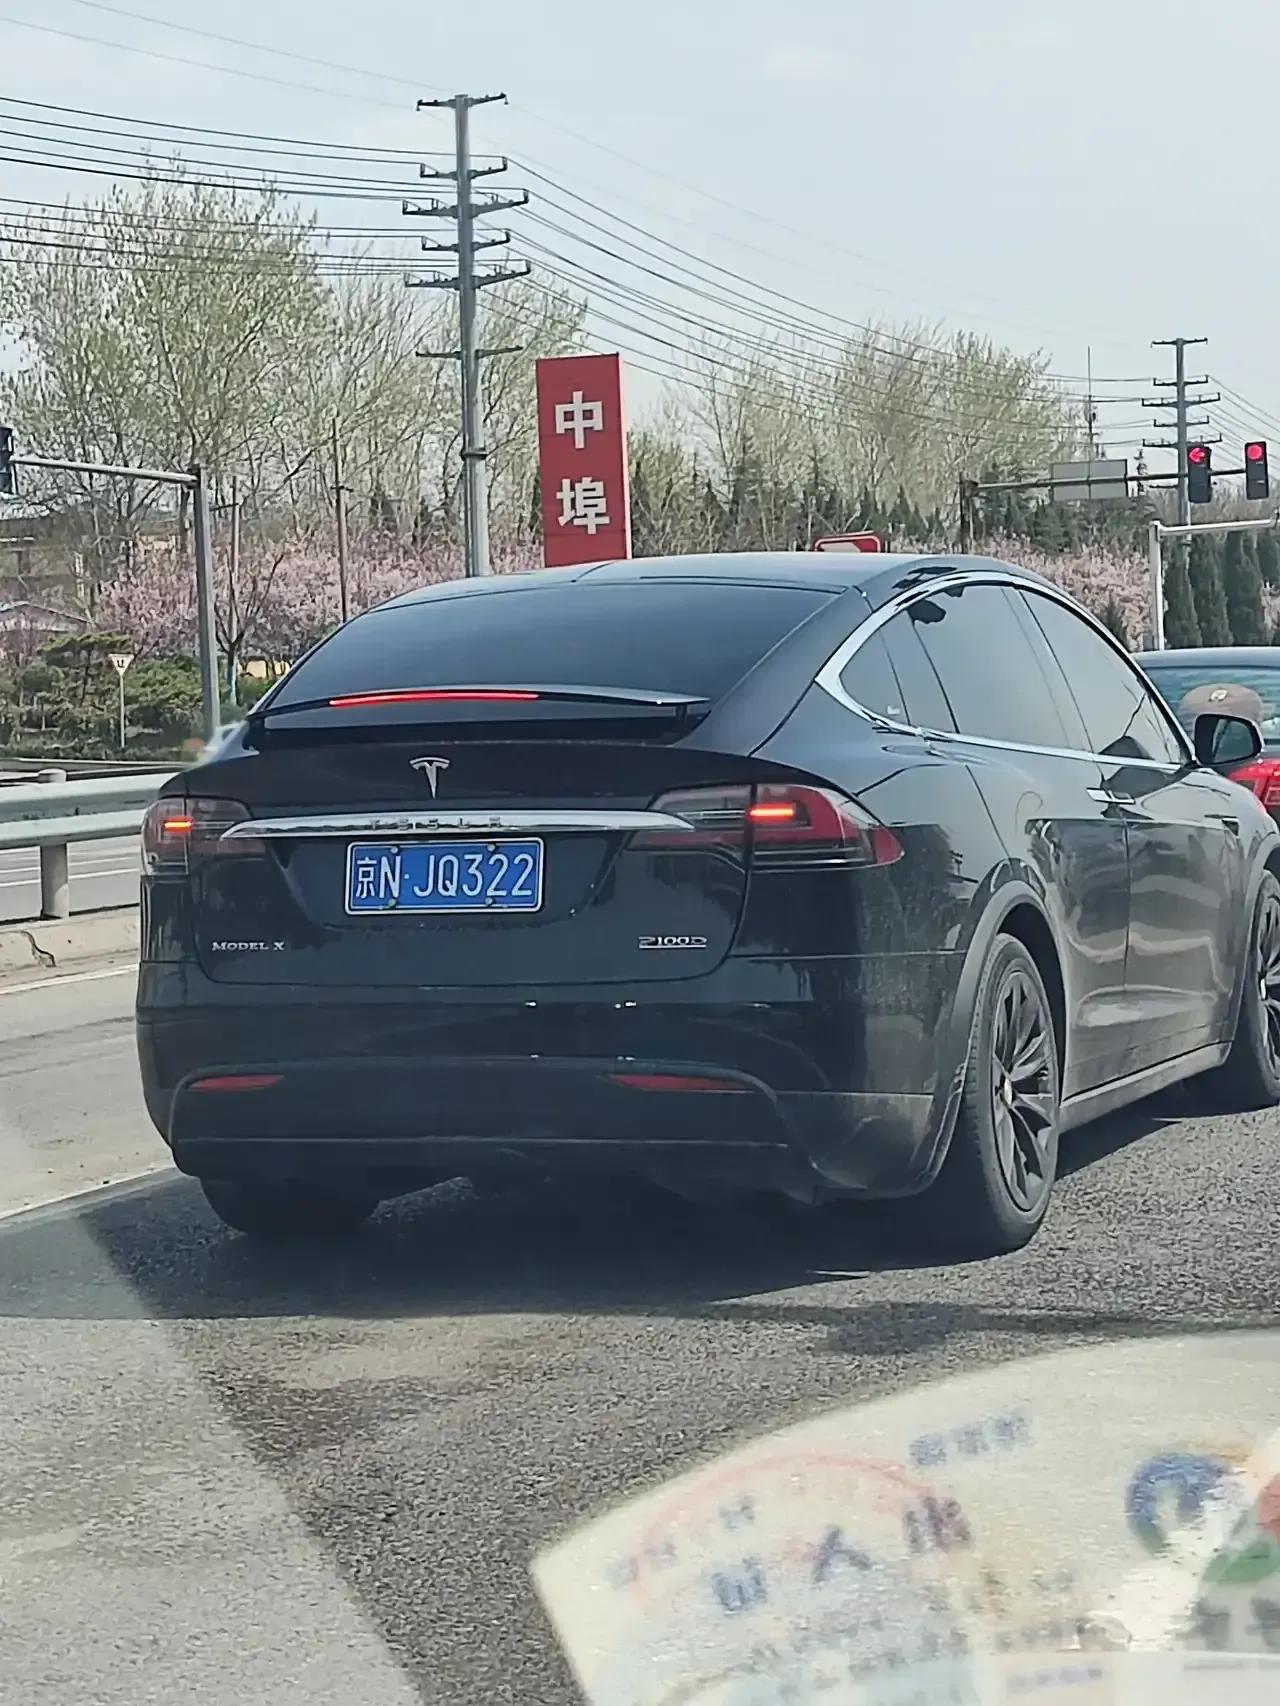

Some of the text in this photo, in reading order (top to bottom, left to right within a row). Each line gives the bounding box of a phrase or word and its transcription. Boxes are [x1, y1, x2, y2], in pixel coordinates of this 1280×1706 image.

[555, 391, 610, 535] 中埠
[356, 853, 534, 898] 京N·JQ322
[212, 941, 285, 952] MODEL X
